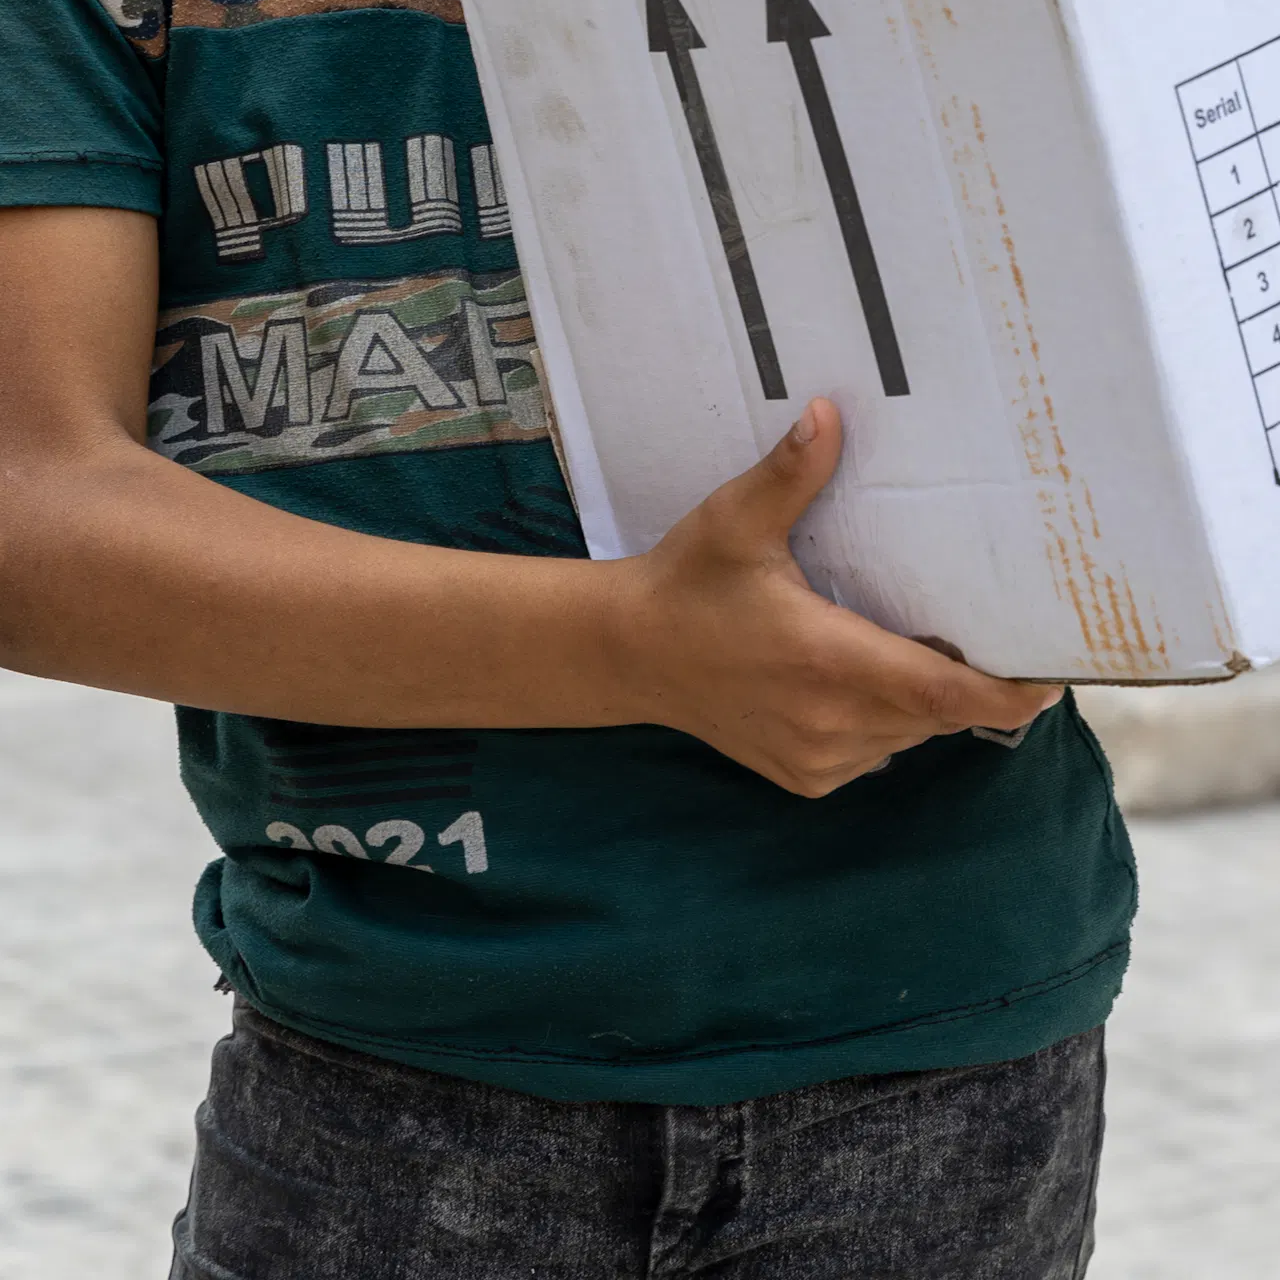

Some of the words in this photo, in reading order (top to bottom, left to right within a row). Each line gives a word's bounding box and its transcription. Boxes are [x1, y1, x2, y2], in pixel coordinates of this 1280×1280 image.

[1193, 89, 1243, 130] Serial
[1229, 163, 1241, 186] 1
[1242, 216, 1257, 241] 2
[1256, 270, 1270, 294] 3
